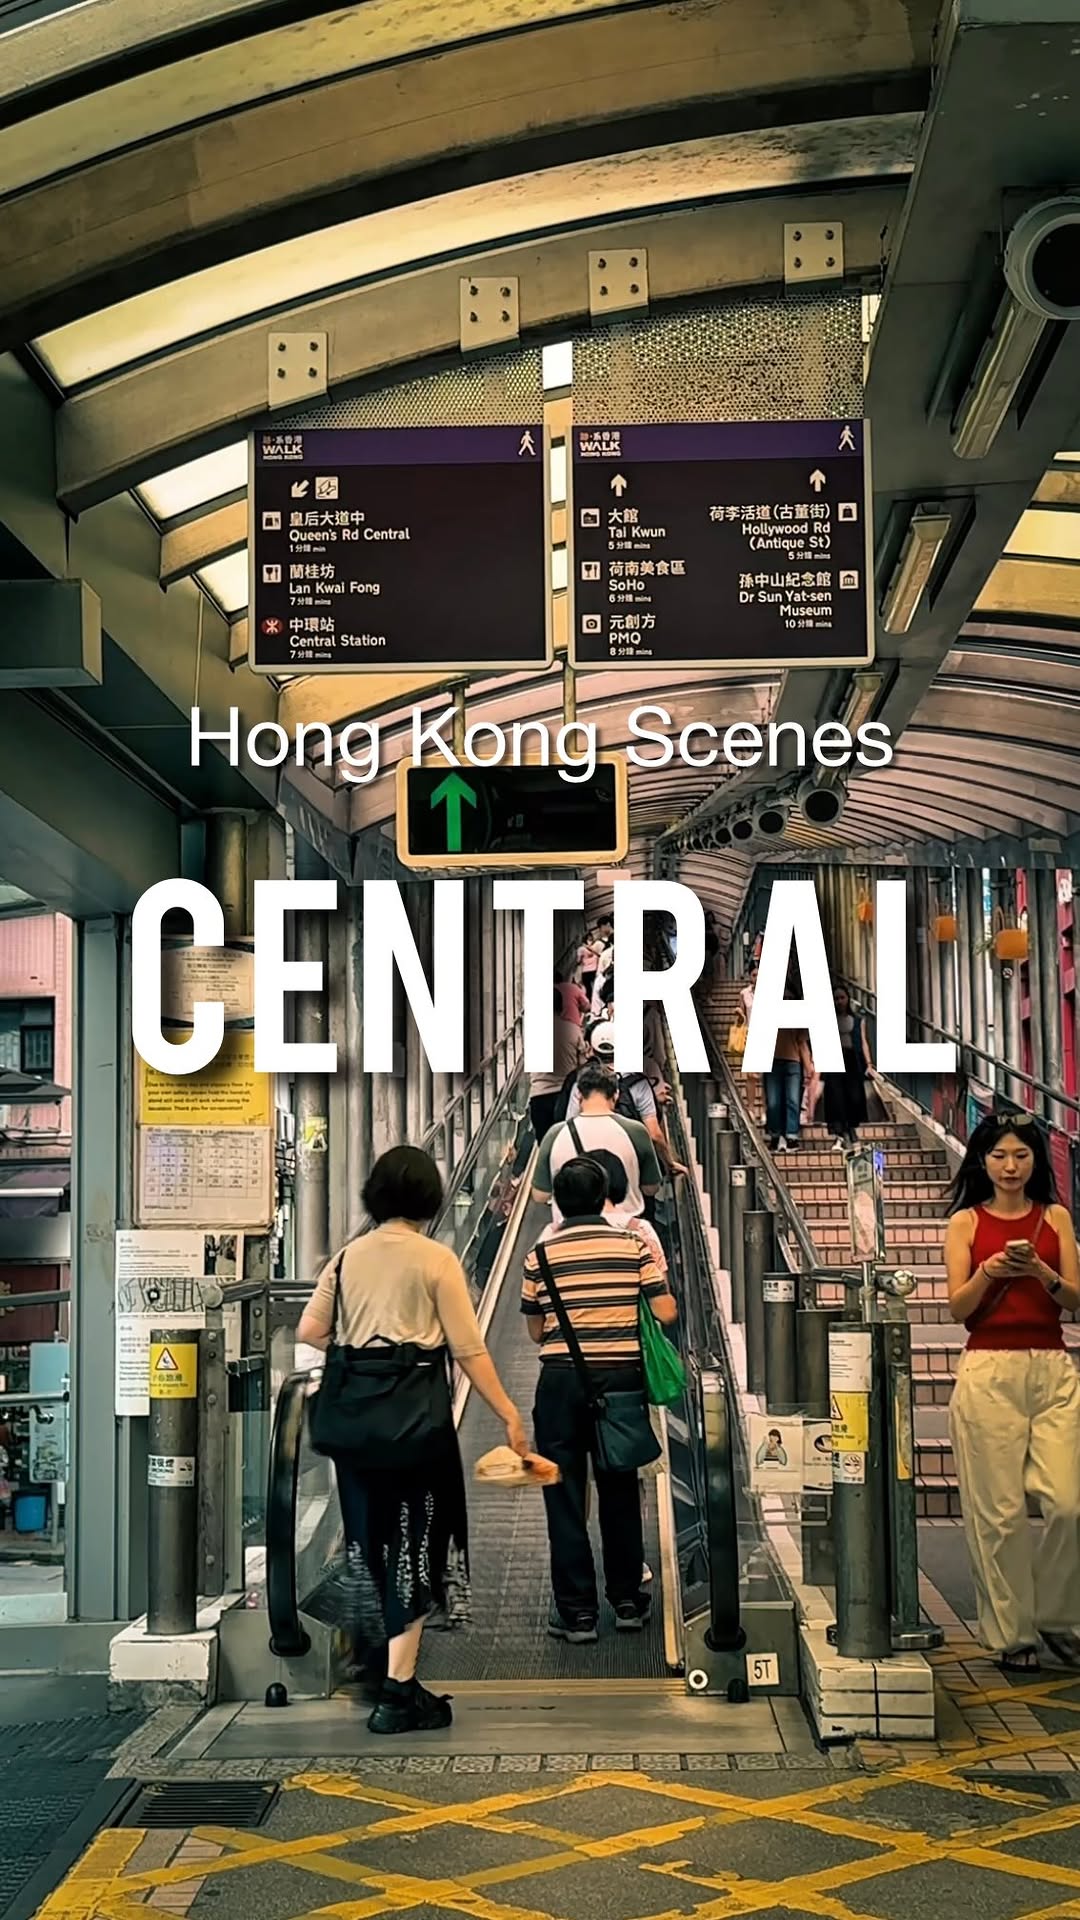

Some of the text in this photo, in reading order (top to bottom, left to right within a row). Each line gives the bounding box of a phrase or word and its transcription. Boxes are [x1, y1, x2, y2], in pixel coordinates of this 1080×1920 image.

[262, 444, 303, 454] WALK
[579, 441, 621, 451] WALK
[289, 510, 365, 527] 皇后大道中
[607, 508, 639, 524] 大館
[289, 527, 411, 542] Queen's Rd Central
[607, 525, 666, 539] Tai Kwun
[742, 521, 831, 537] Hollywood Rd
[749, 534, 831, 551] (Antique St)
[289, 563, 336, 580] 蘭桂坊
[608, 560, 686, 577] 荷南美食區
[608, 578, 645, 592] SoHo
[738, 571, 832, 589] 孫中山紀念館
[289, 581, 380, 596] Lan Kwai Fong
[739, 589, 832, 604] Dr Sun Yat-sen
[779, 604, 832, 617] Museum
[289, 616, 335, 633] 中環站
[609, 613, 656, 630] 元創方
[289, 633, 386, 648] Central Station
[609, 631, 642, 646] PMQ
[754, 1659, 772, 1680] 5T
